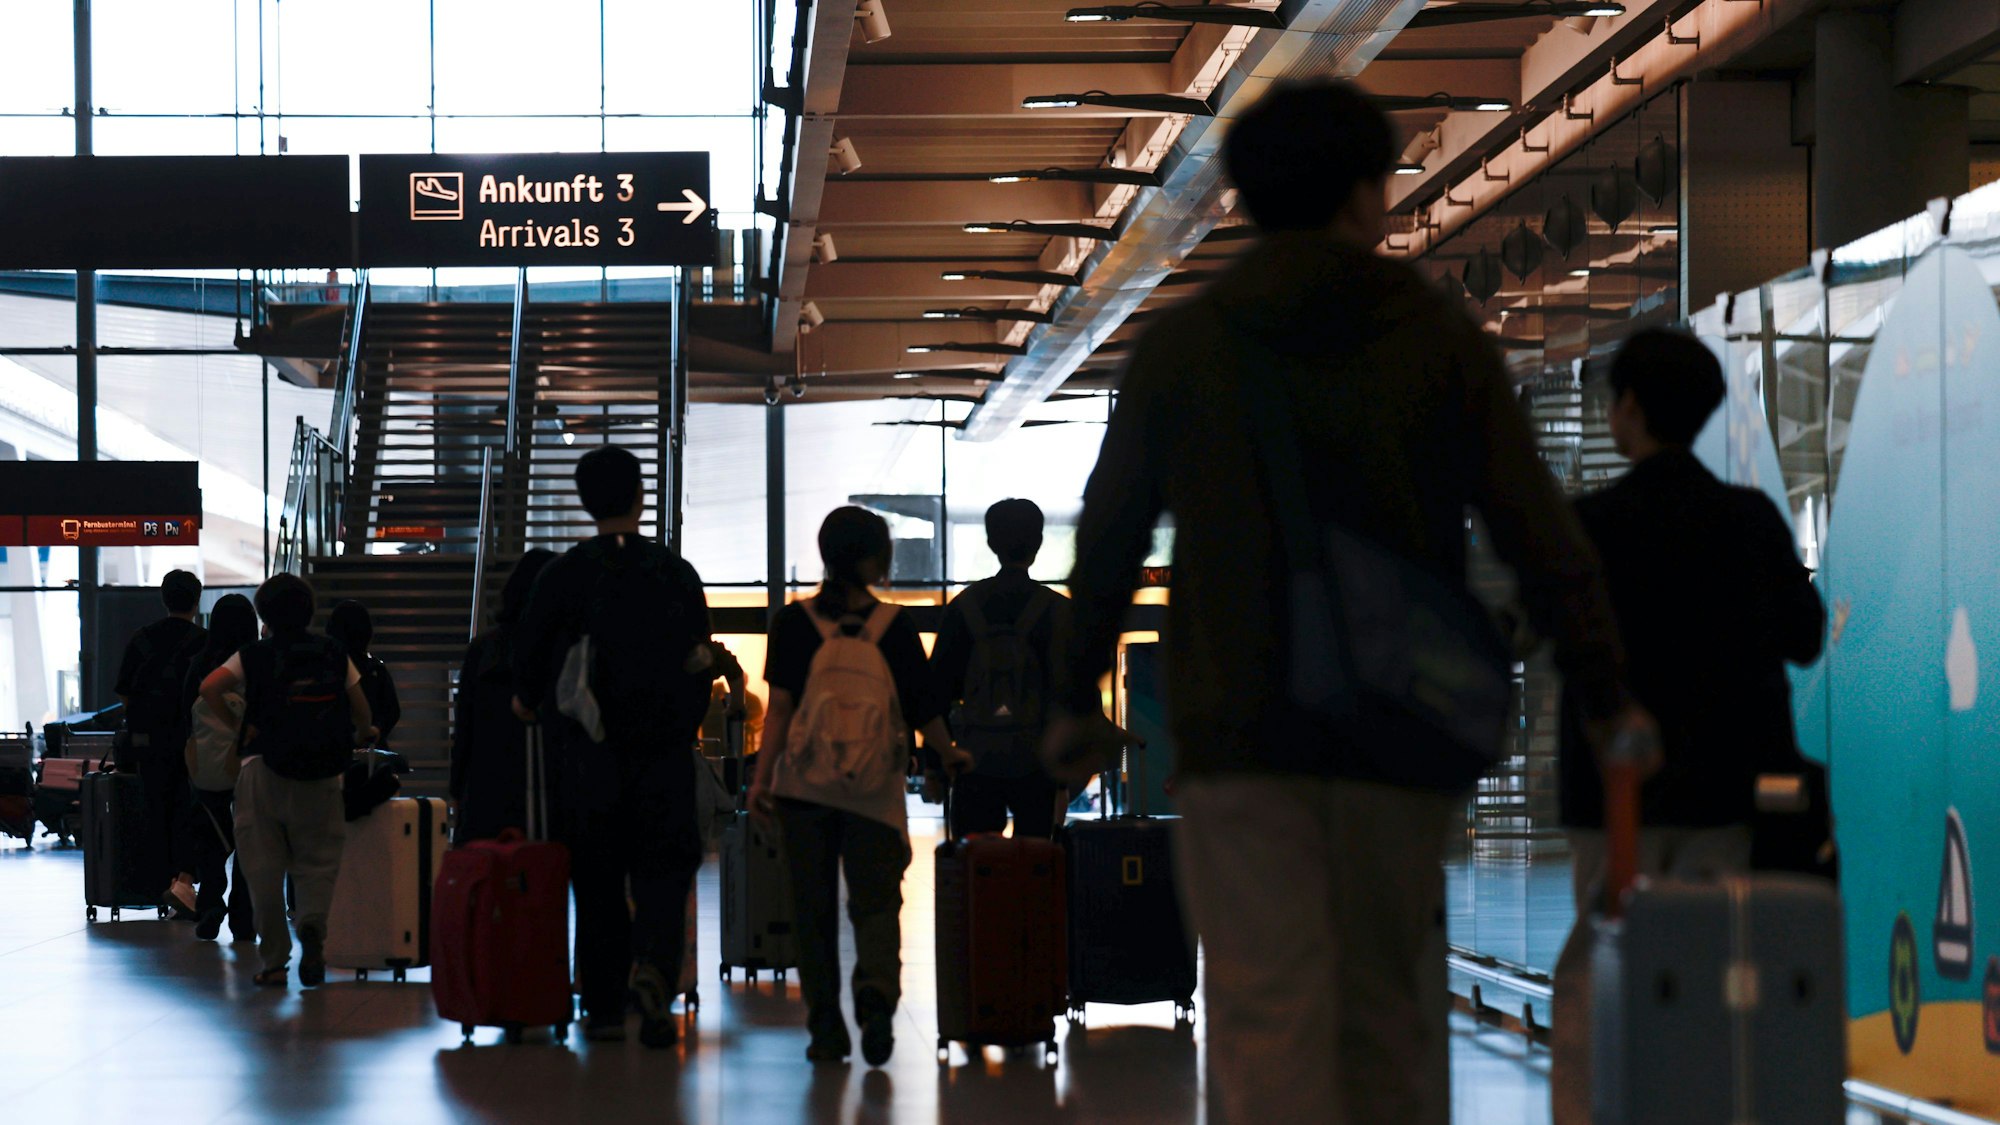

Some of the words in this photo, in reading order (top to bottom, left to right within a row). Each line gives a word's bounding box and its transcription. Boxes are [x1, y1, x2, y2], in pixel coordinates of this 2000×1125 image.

[480, 174, 604, 203] Ankunft
[617, 174, 634, 201] 3
[480, 218, 600, 247] Arrivals
[617, 218, 634, 246] 3
